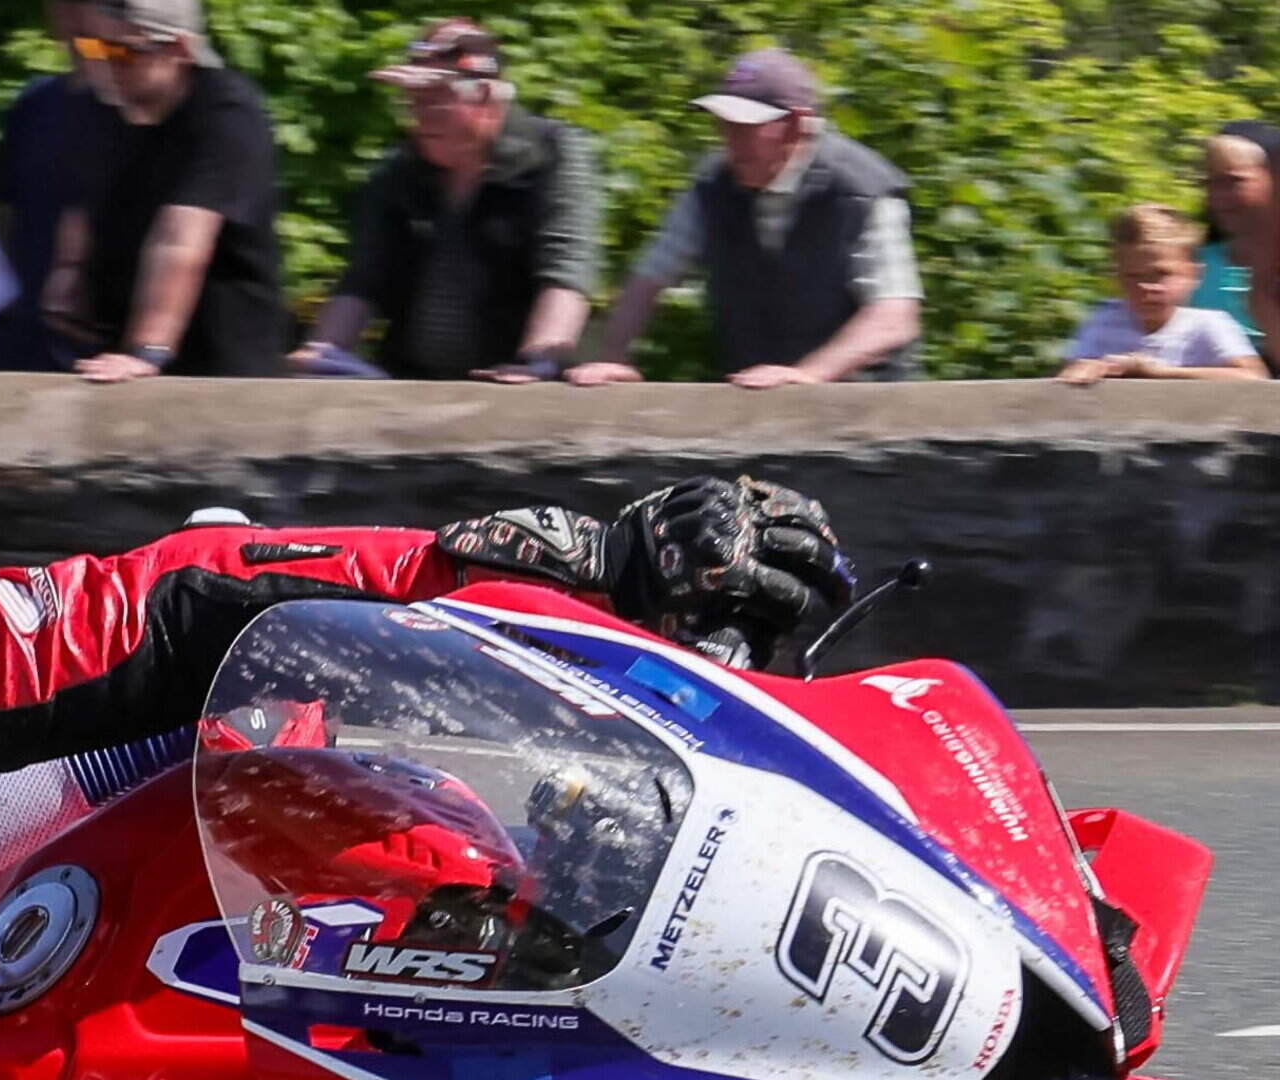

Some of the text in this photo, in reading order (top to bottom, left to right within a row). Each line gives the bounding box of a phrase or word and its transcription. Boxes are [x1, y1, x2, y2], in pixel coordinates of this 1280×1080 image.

[650, 826, 727, 971] METZELER
[345, 943, 497, 982] WRS
[777, 848, 974, 1067] 3
[363, 1003, 579, 1030] Honda RACING
[972, 987, 1019, 1070] HONDA
